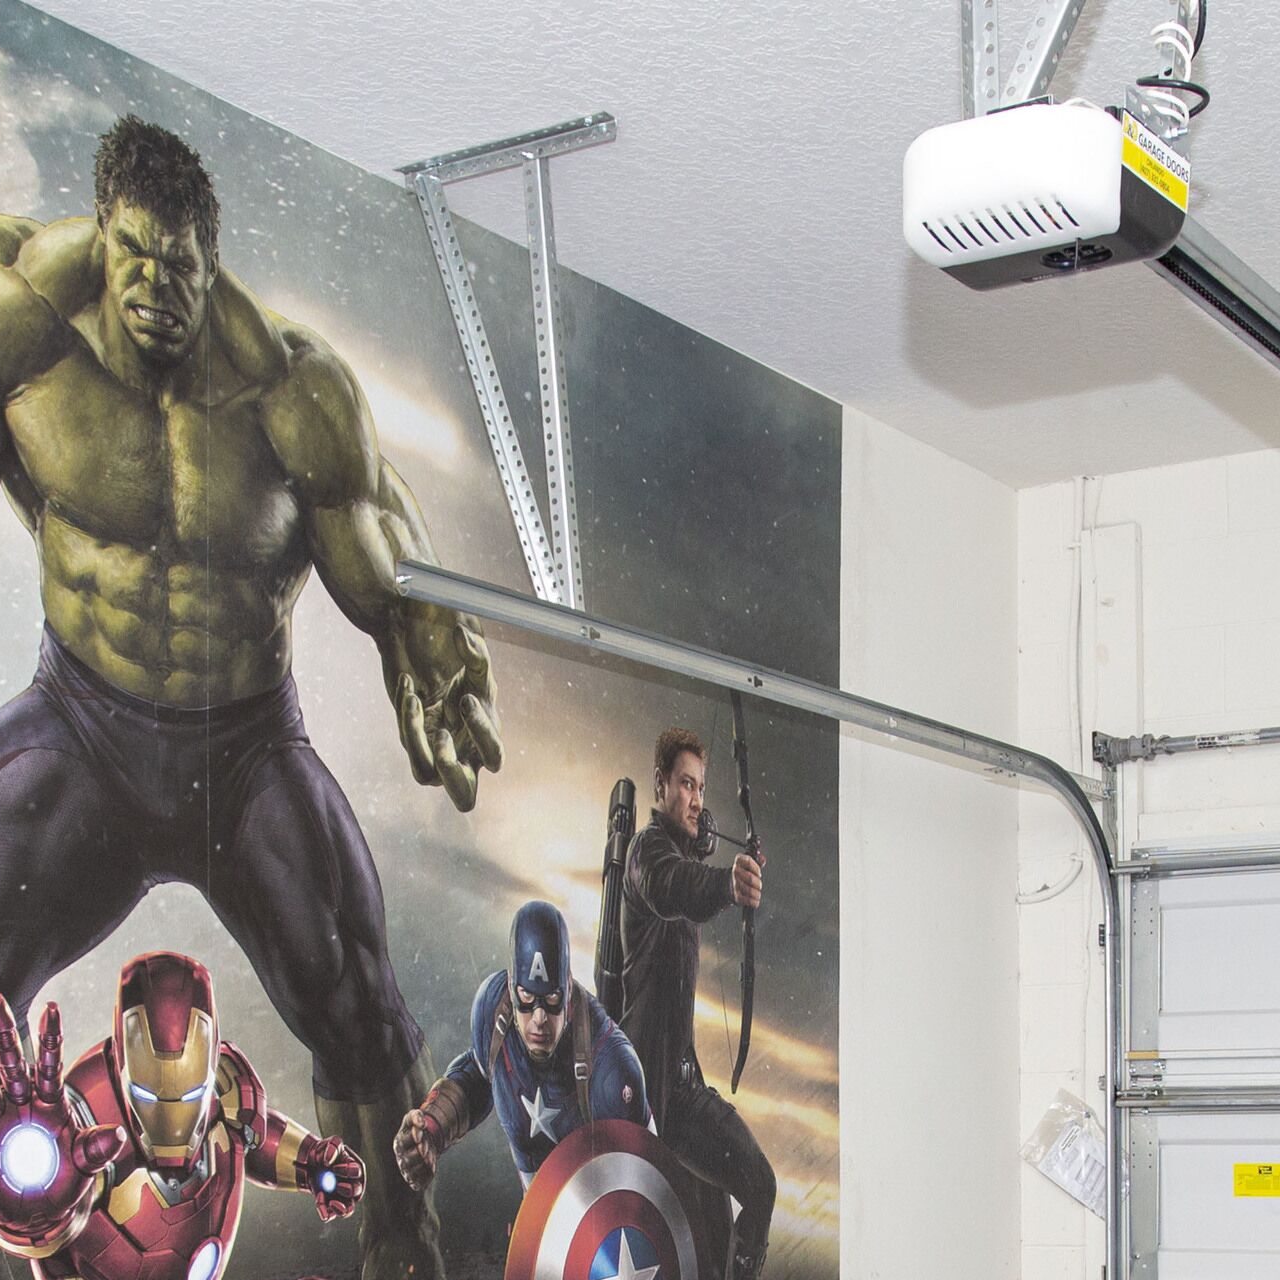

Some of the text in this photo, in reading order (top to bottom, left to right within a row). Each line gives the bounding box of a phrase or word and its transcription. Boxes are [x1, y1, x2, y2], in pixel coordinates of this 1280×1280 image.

[1139, 134, 1165, 165] GARAGE
[1166, 155, 1189, 183] DOORS
[528, 951, 549, 982] A
